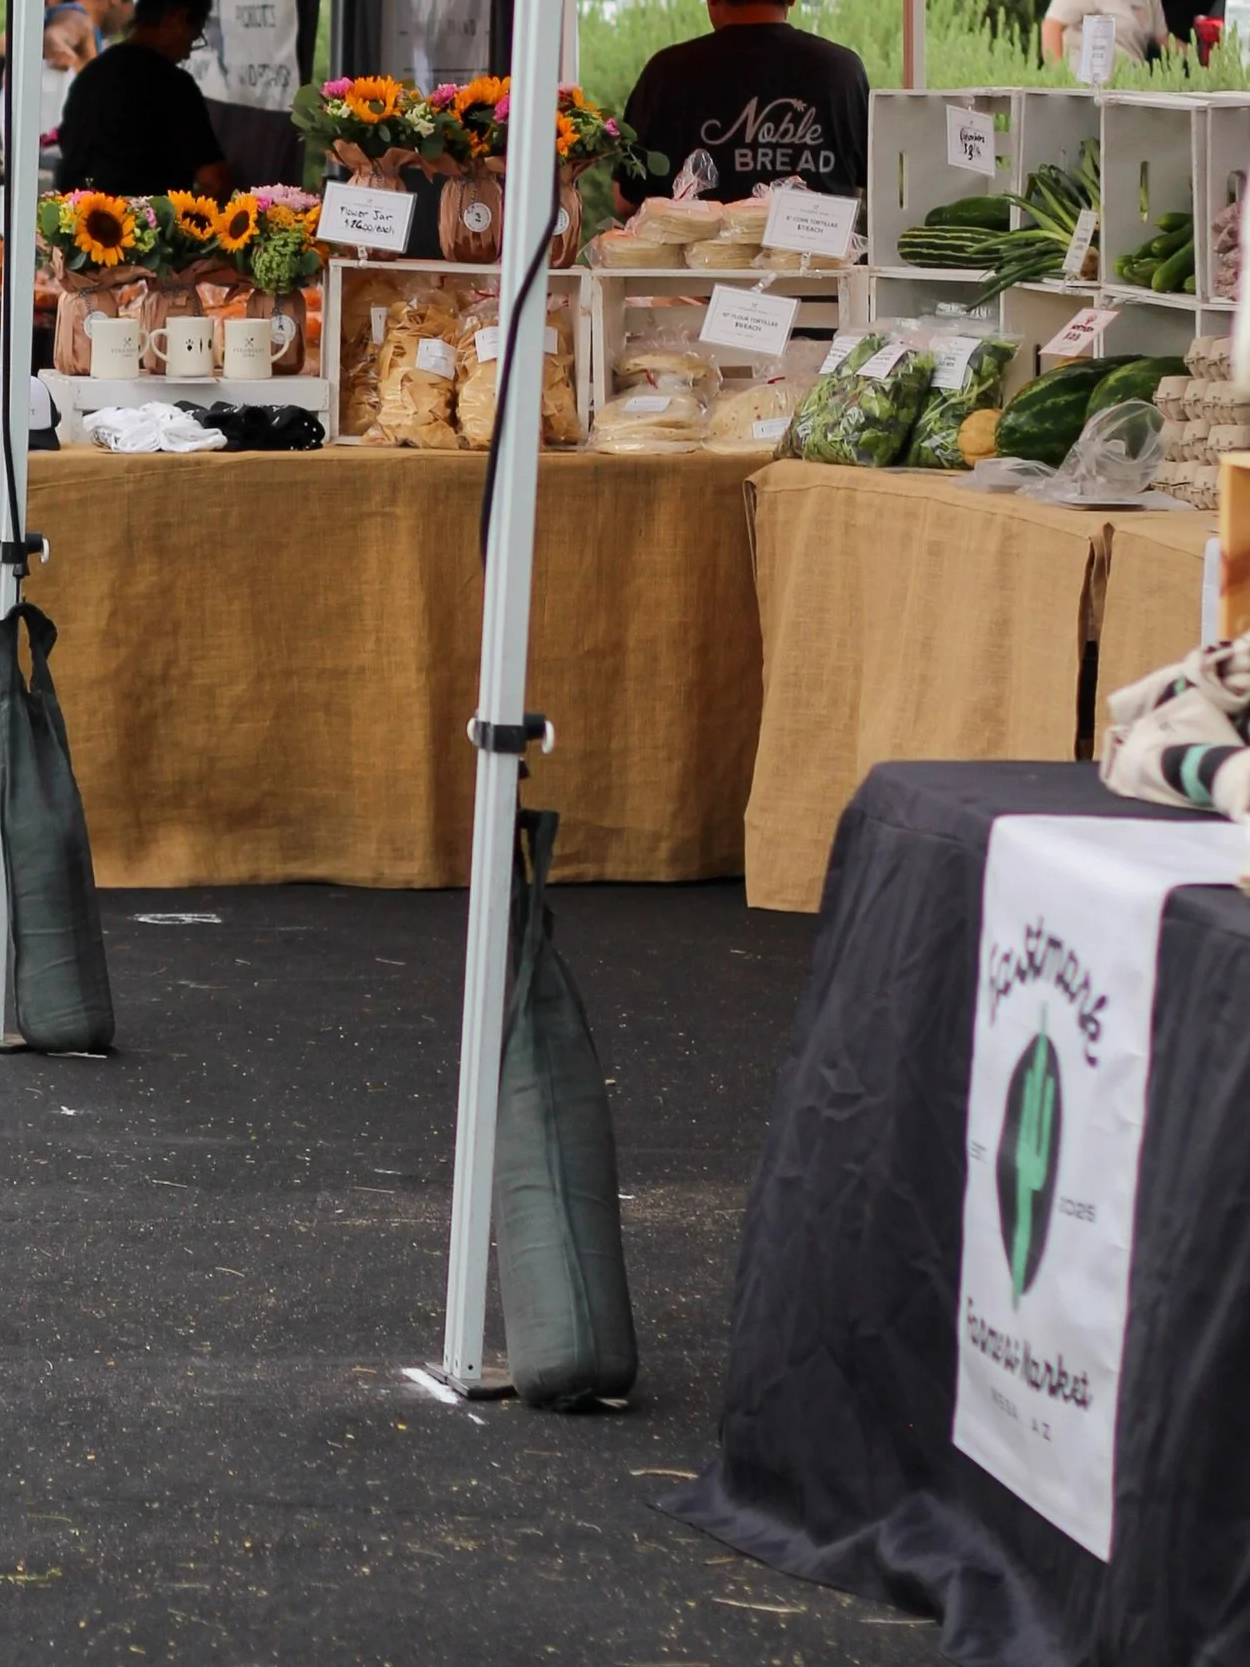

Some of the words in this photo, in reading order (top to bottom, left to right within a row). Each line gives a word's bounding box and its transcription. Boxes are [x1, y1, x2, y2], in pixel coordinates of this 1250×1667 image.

[701, 96, 824, 146] Noble
[734, 148, 836, 174] BREAD
[340, 205, 370, 220] Flower
[373, 209, 394, 222] Jar
[810, 218, 838, 229] TORTILLAS
[749, 316, 778, 328] TORTILLAS
[1020, 1339, 1093, 1412] Market
[1031, 1417, 1052, 1443] AZ
